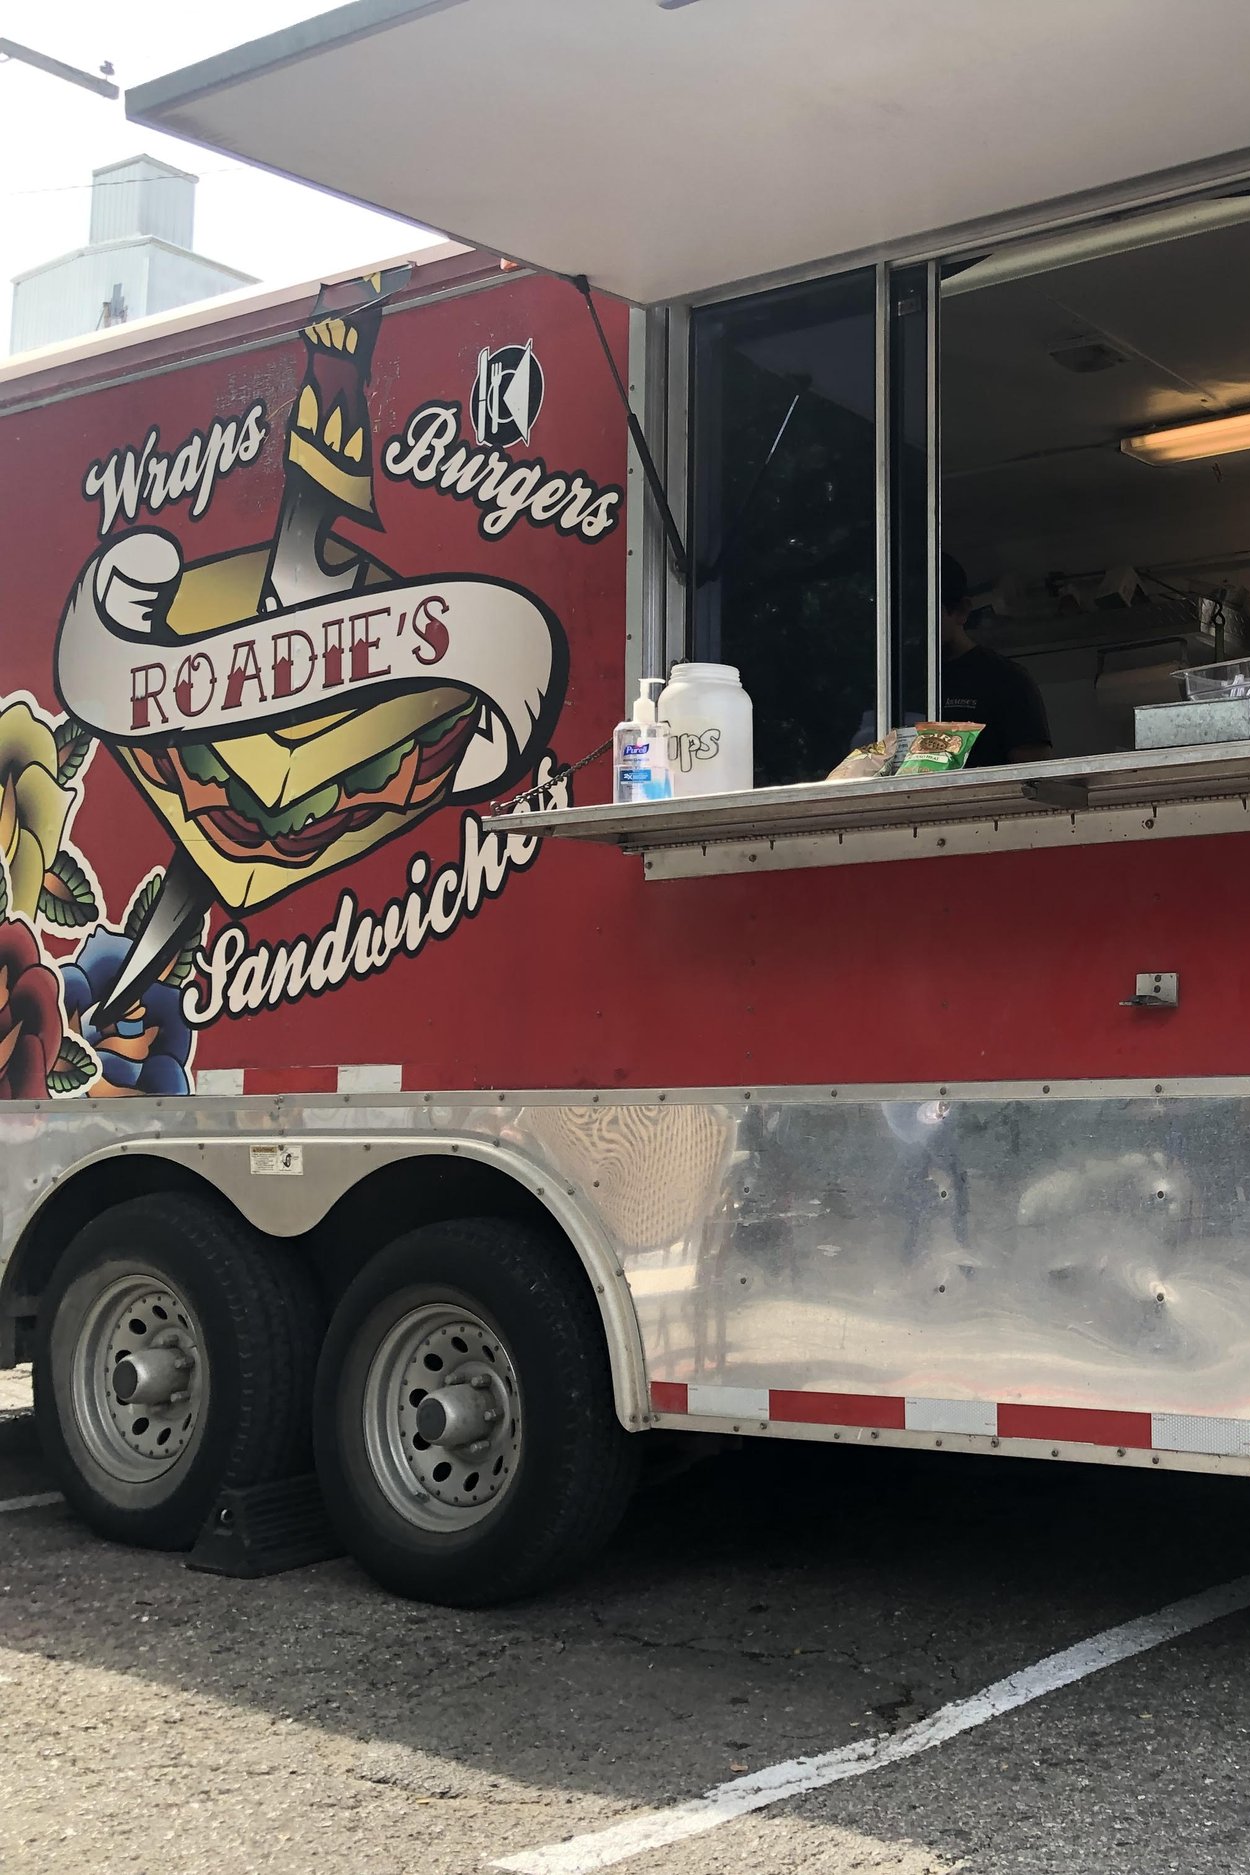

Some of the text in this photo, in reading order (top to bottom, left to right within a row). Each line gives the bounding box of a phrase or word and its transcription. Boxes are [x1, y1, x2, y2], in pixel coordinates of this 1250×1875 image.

[85, 405, 266, 535] Wraps
[385, 406, 619, 537] Burgers
[130, 595, 450, 730] ROADIE'S
[660, 720, 721, 773] ips
